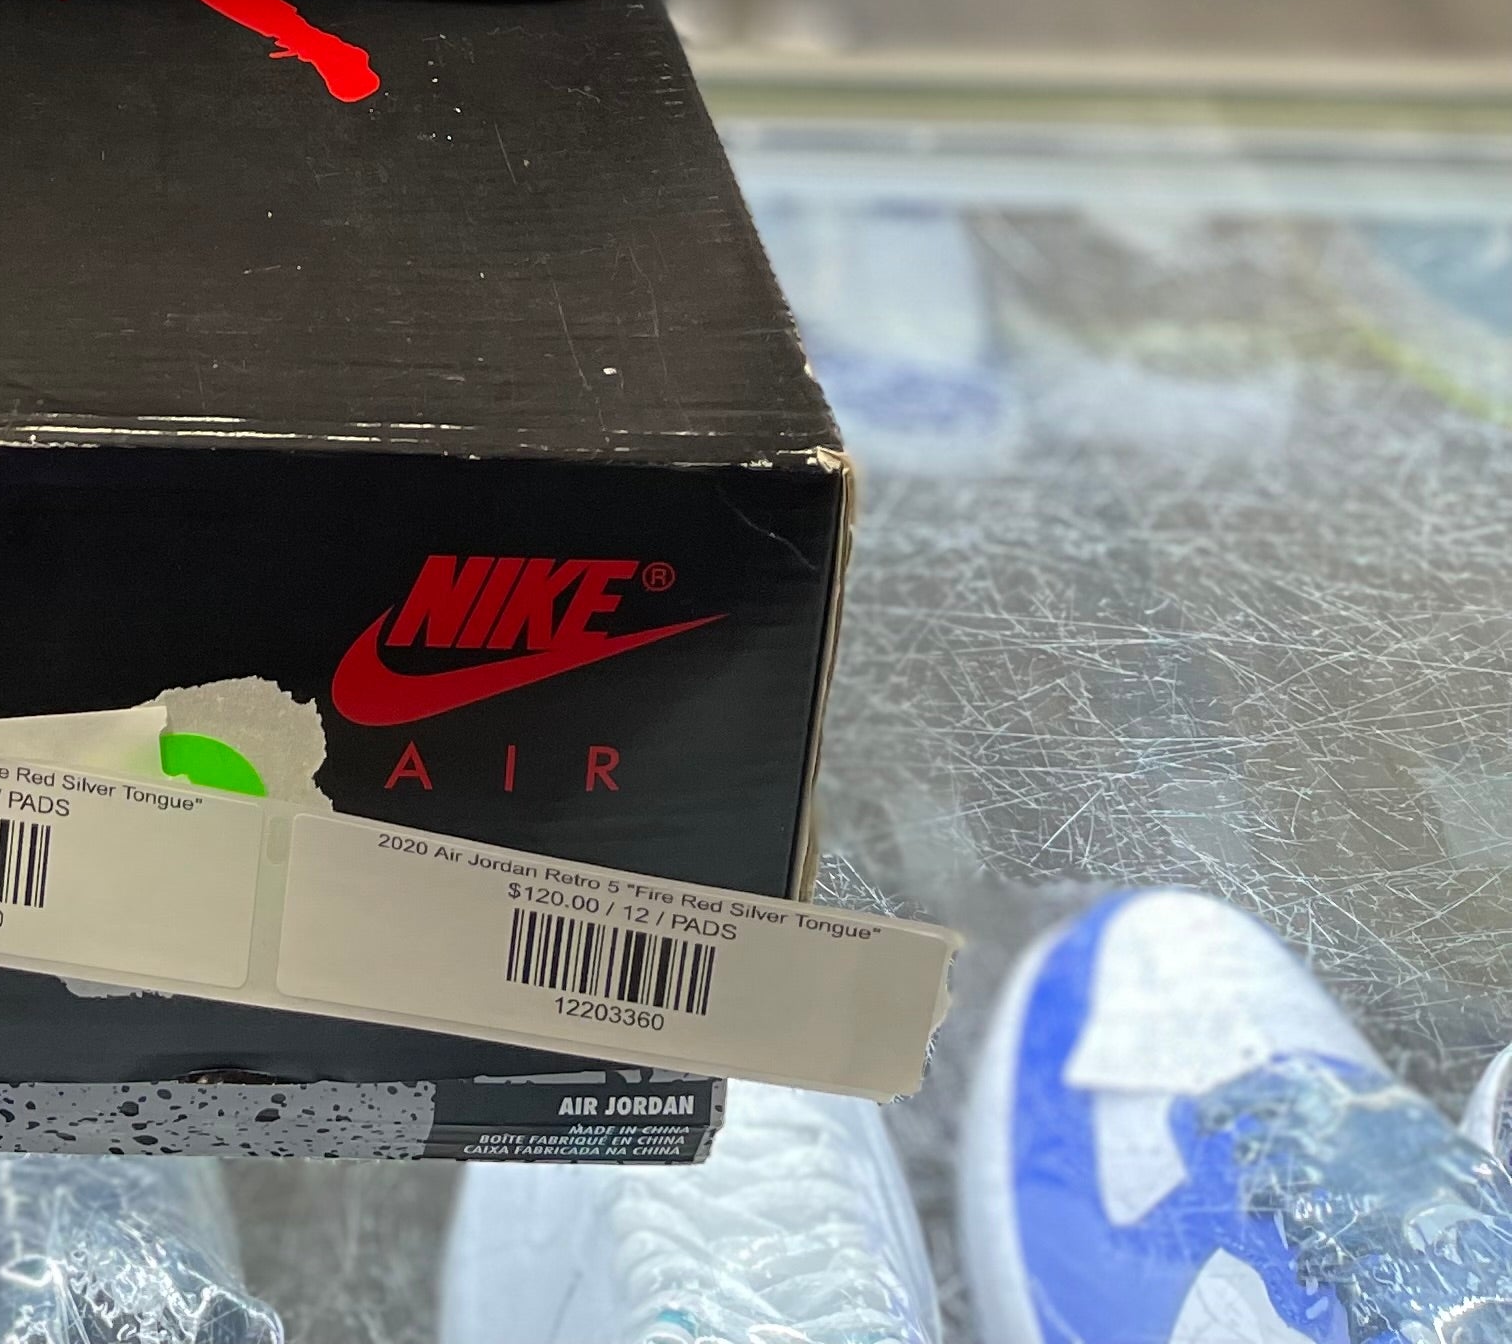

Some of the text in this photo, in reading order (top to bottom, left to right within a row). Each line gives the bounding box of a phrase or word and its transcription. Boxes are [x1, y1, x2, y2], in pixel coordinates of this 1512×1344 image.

[385, 555, 640, 650] NIKE
[384, 740, 621, 792] AIR
[8, 790, 70, 817] PADS
[16, 767, 54, 786] Red
[62, 775, 116, 797] Silver
[122, 784, 203, 811] Tongue"
[378, 833, 881, 940] 2020 Air Jordan Retro 5 "Fire Red Silver Tongue"
[508, 882, 737, 940] $120.00 / 12 / PADS
[554, 996, 666, 1032] 12203360
[558, 1096, 694, 1115] AIR JORDAN
[480, 1133, 524, 1145] BOÎTE
[612, 1136, 631, 1146] EN
[637, 1136, 686, 1146] CHINA
[568, 1125, 690, 1135] MADE IN CHINA
[464, 1144, 681, 1156] CAIXA FABRICADA NA CHINA
